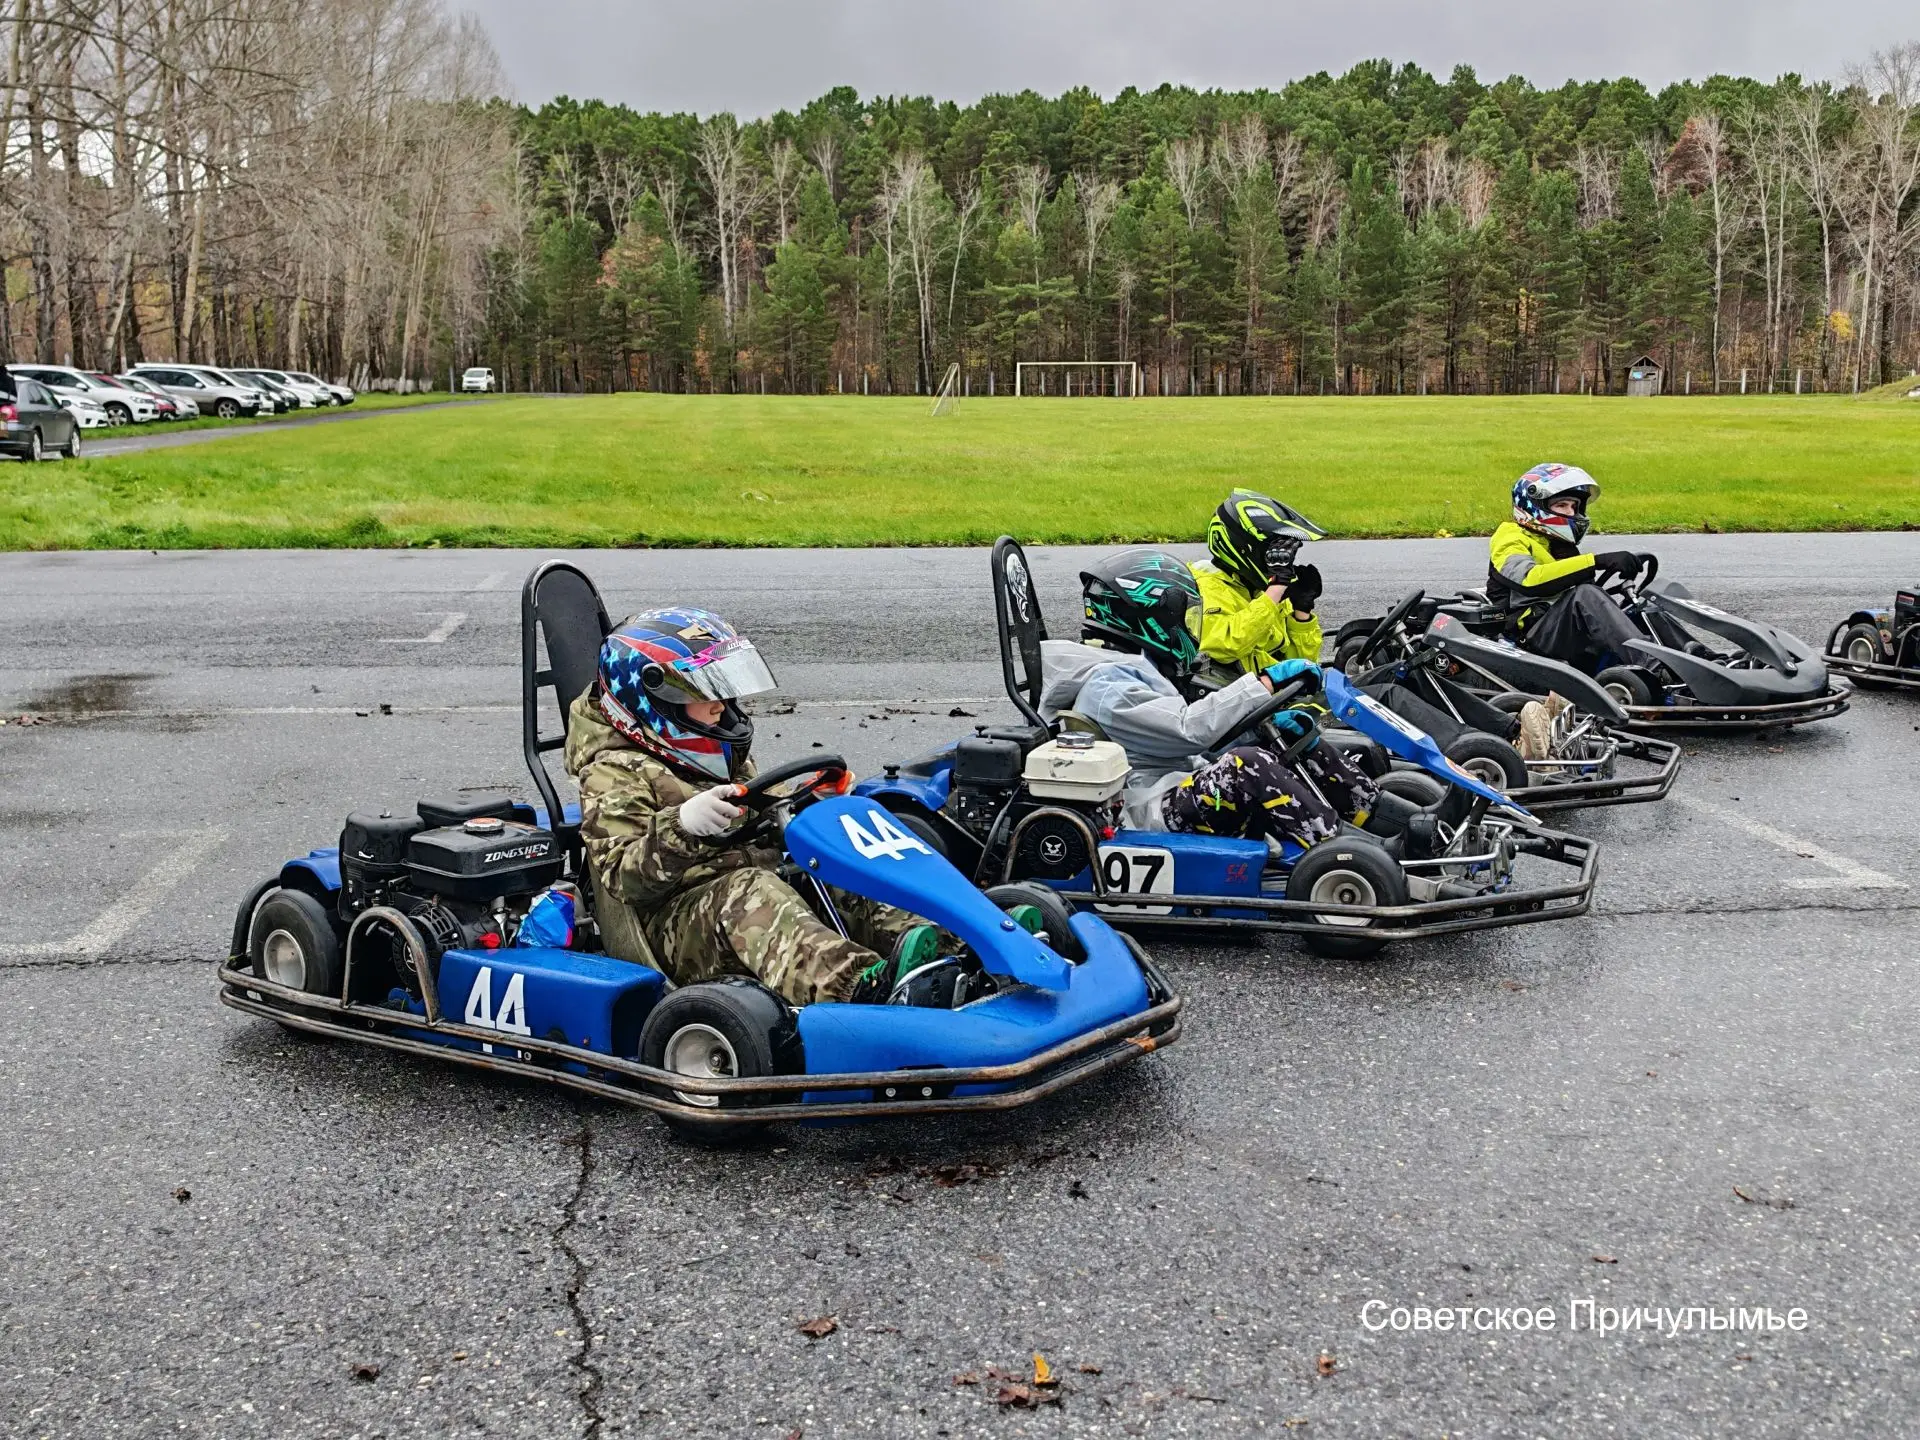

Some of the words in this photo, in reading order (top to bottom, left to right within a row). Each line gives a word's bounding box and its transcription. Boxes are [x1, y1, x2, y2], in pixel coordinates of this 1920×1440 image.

[484, 841, 550, 863] ZONGSHEN
[840, 809, 933, 861] 44
[1103, 851, 1165, 909] 97
[464, 966, 532, 1058] 44
